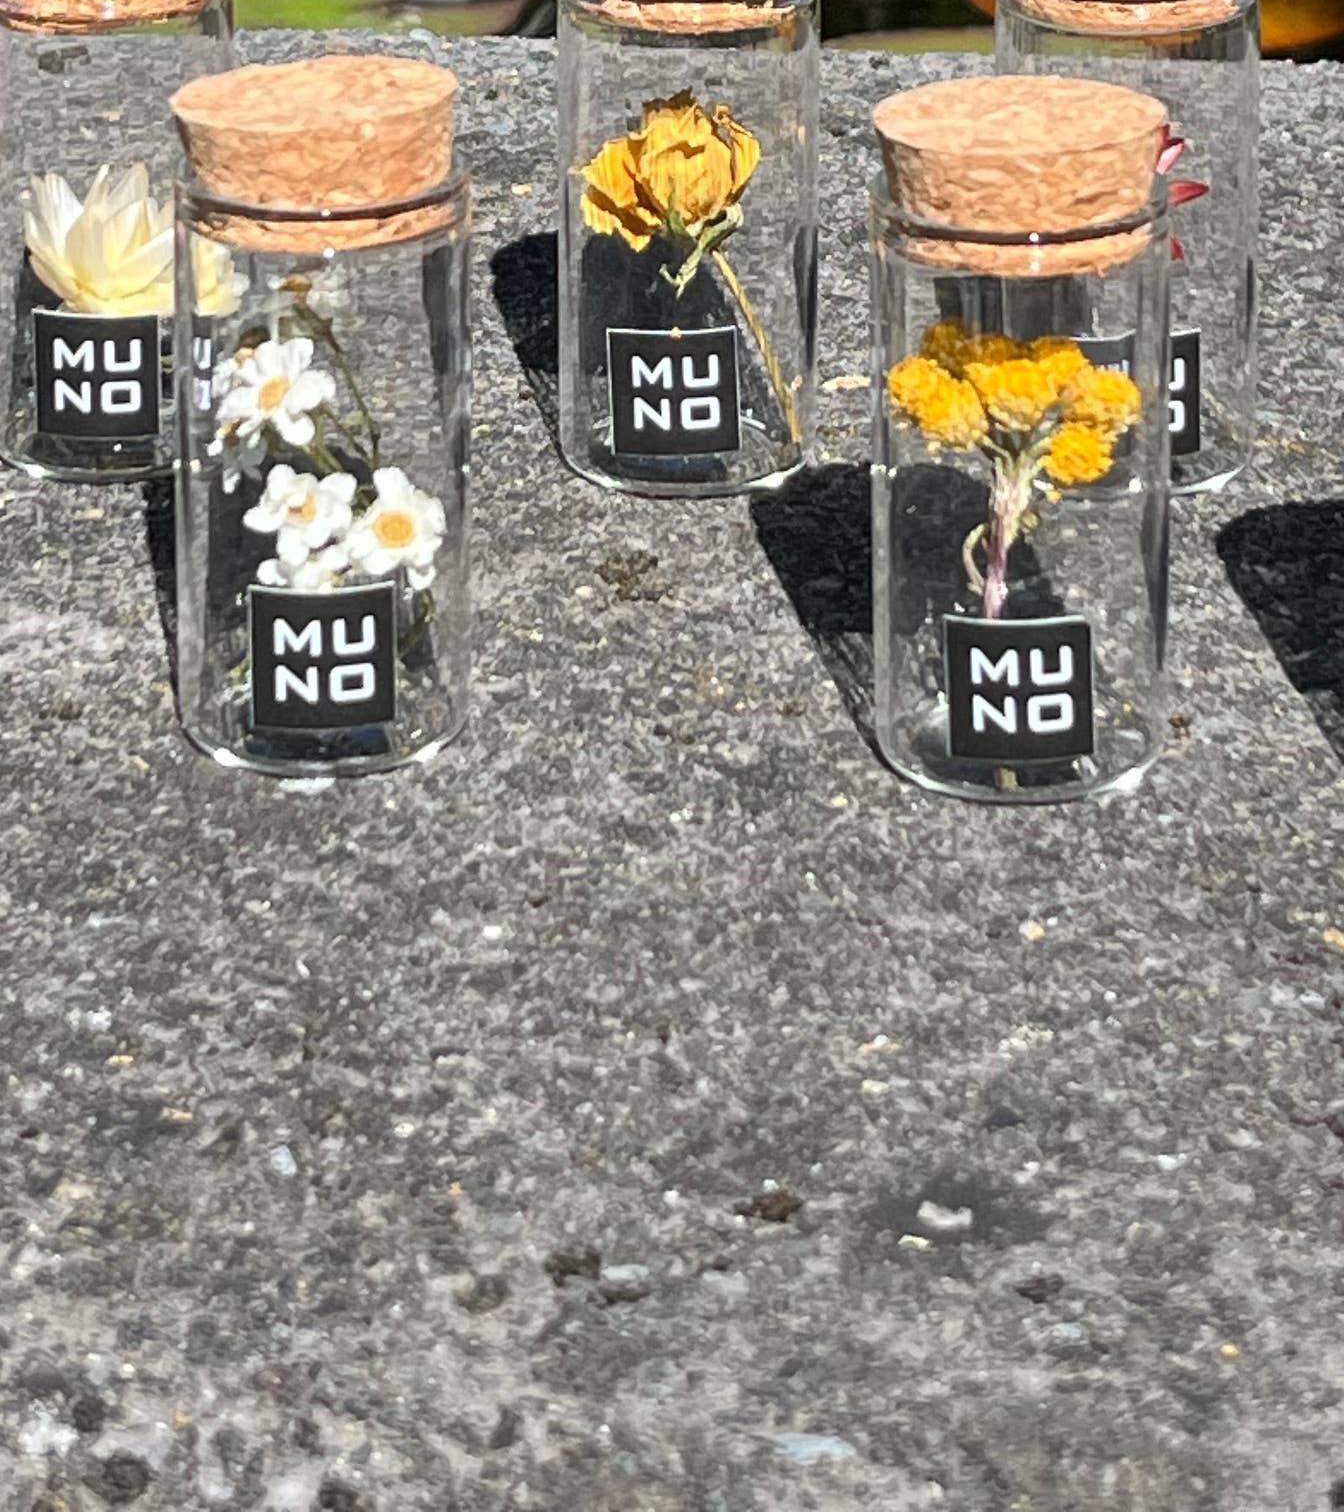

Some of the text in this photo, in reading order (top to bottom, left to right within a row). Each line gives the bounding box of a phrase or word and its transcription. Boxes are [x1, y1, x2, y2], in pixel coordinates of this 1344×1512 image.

[53, 338, 142, 373] MU
[631, 354, 720, 389] MU
[53, 379, 142, 414] NO
[633, 396, 721, 431] NO
[273, 615, 376, 657] MU
[275, 662, 376, 703] NO
[970, 645, 1074, 687] MU
[972, 693, 1074, 734] NO
